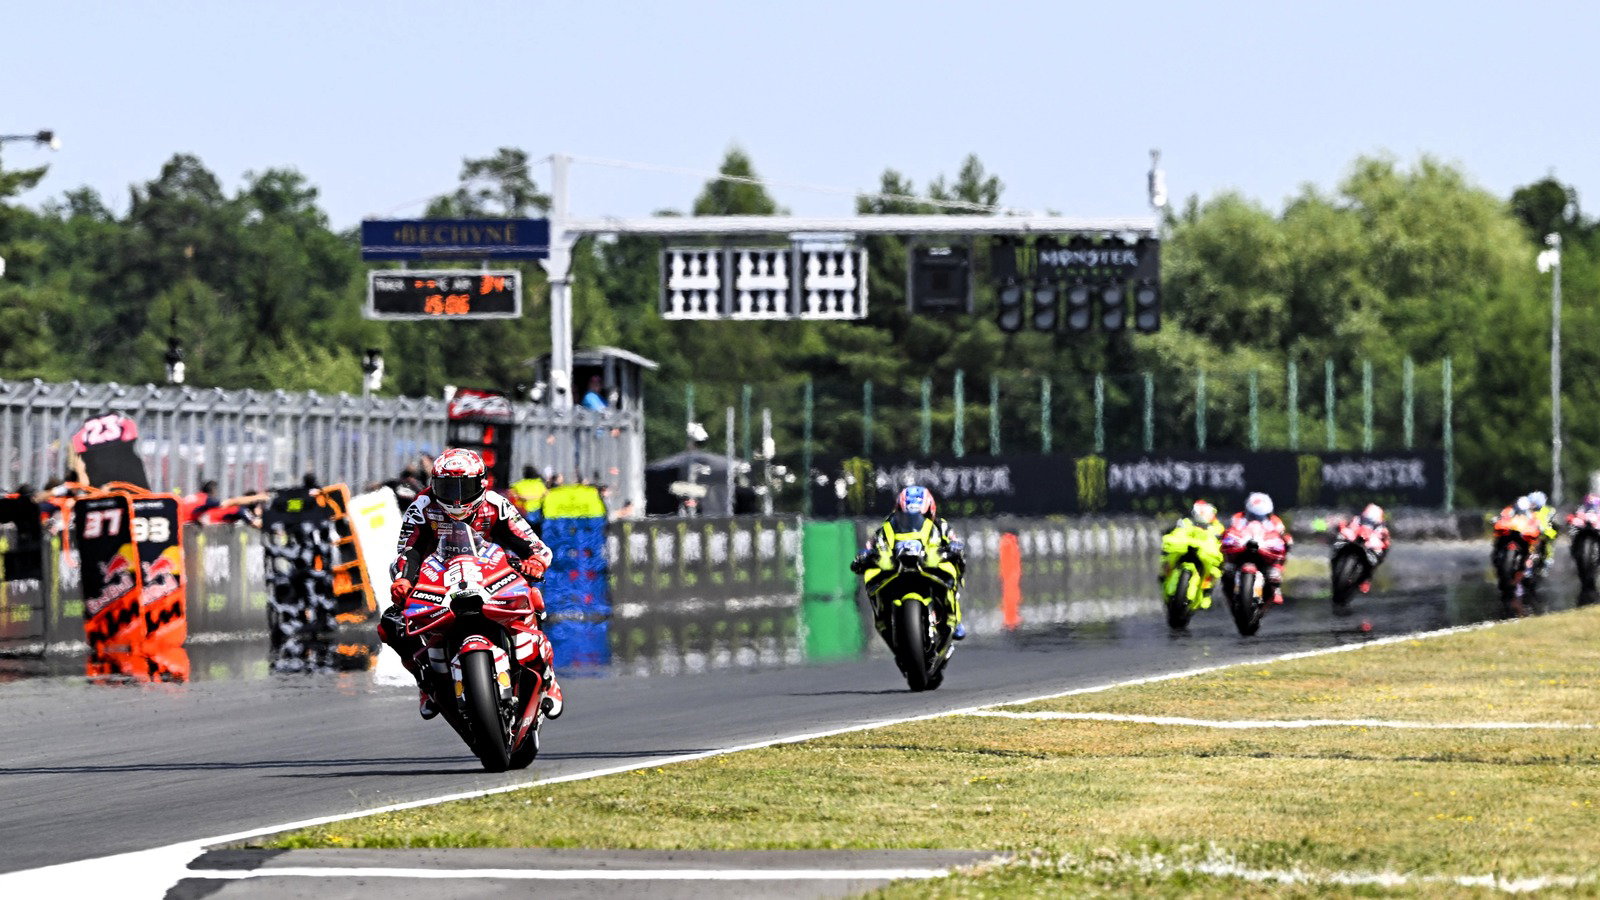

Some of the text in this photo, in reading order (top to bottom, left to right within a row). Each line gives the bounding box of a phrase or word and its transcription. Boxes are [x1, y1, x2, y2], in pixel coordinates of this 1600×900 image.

[84, 414, 122, 445] 23
[83, 508, 123, 539] 37
[485, 573, 518, 593] Lenovo
[412, 590, 443, 603] Lenovo
